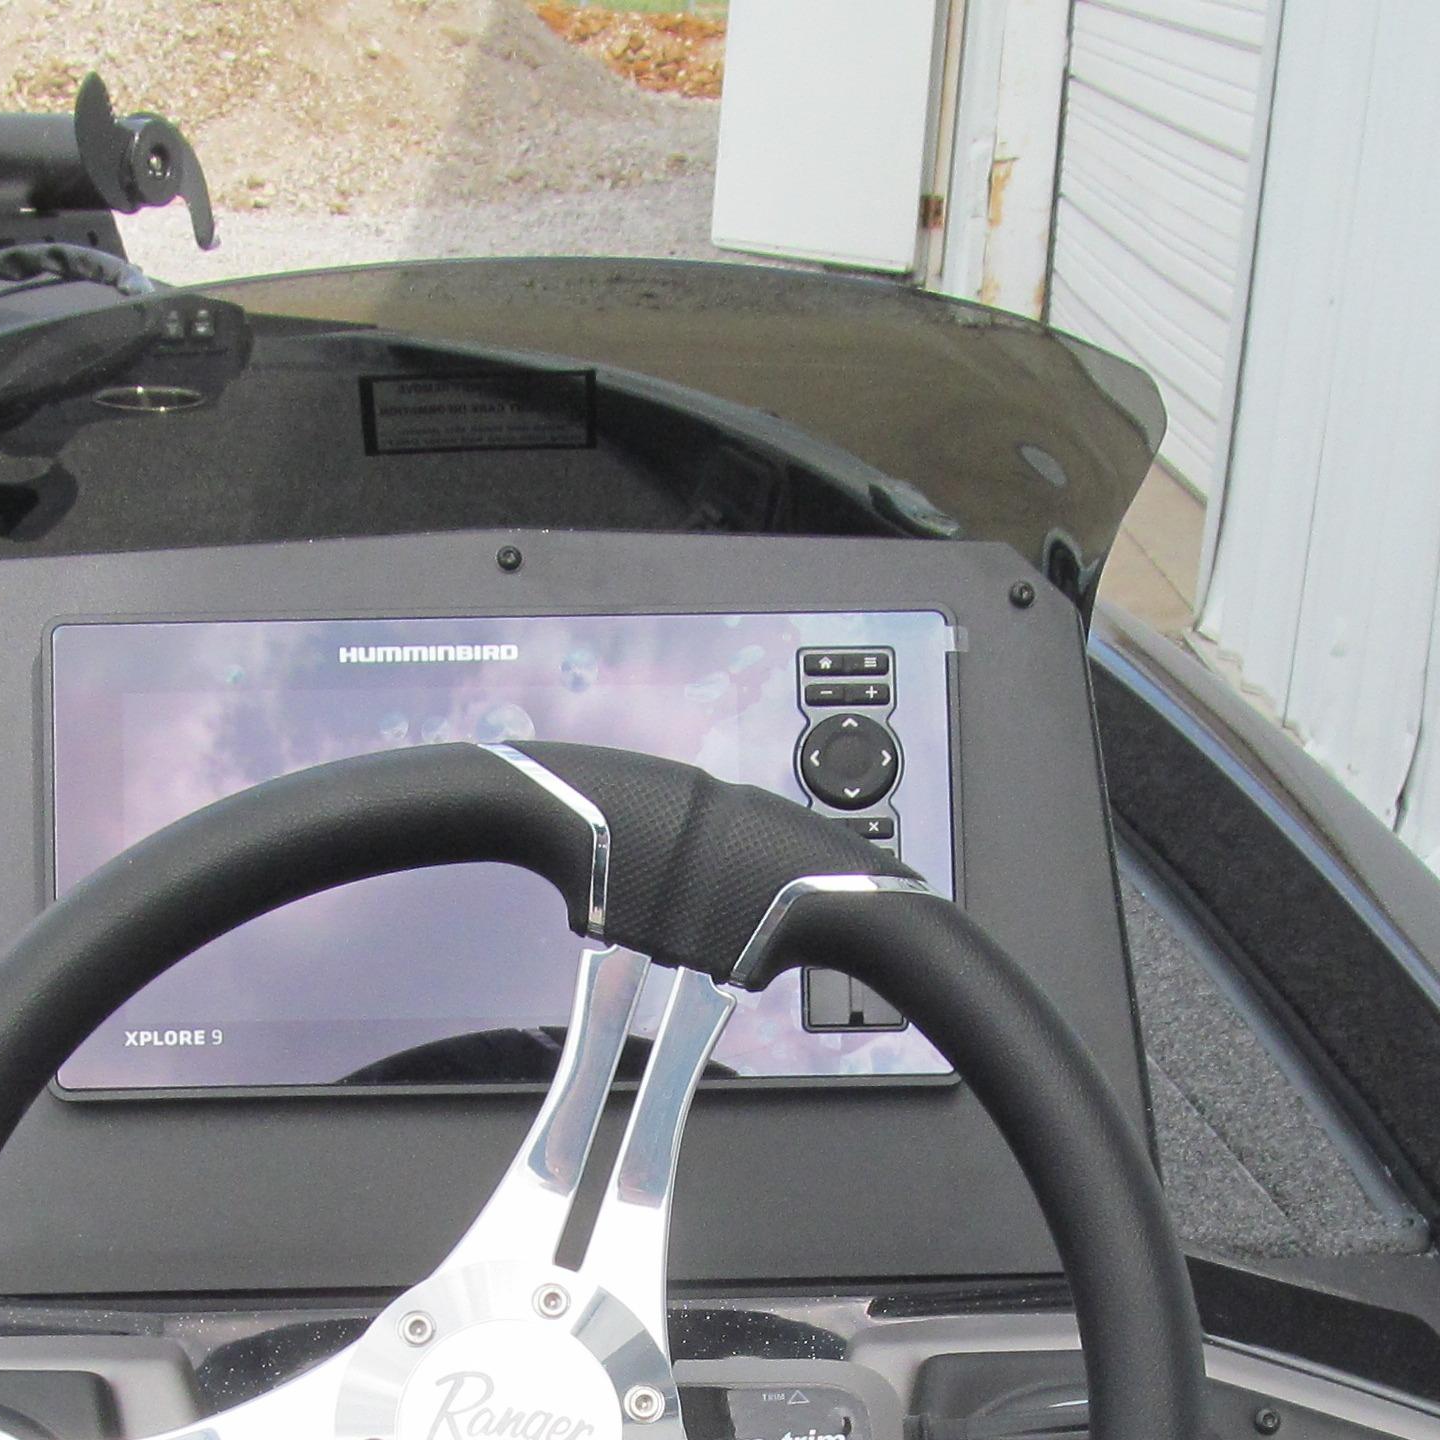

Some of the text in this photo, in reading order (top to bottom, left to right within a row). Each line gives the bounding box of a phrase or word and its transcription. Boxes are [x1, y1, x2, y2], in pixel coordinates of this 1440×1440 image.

[339, 644, 518, 663] HUMMINBIRD
[124, 1029, 223, 1047] XPLORE 9
[762, 1393, 785, 1401] TRIM
